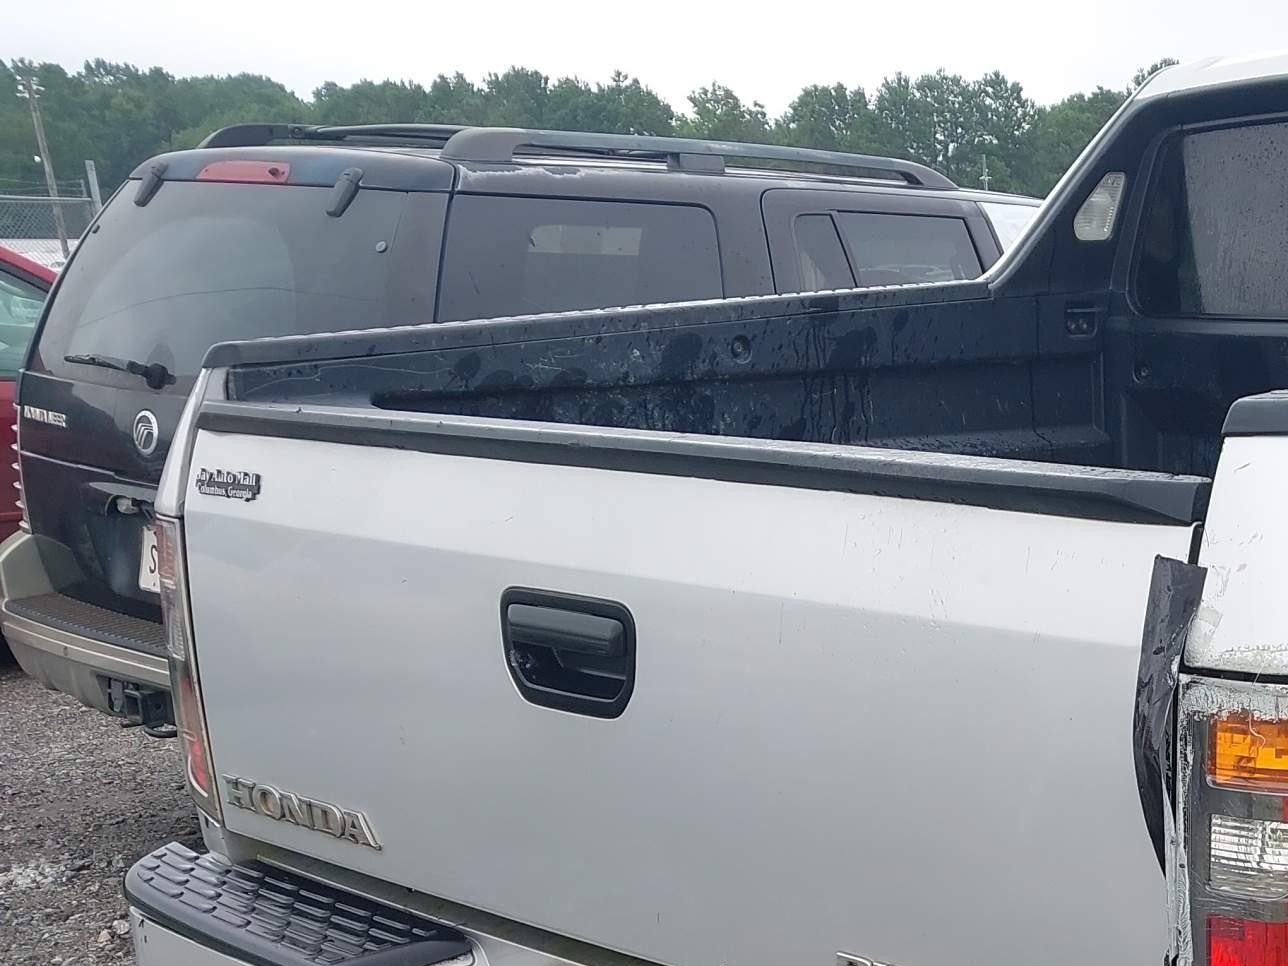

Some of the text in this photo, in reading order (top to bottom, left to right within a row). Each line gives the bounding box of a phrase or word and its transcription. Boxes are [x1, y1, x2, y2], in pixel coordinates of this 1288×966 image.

[211, 470, 234, 483] Auto
[235, 471, 256, 486] Mall
[221, 773, 382, 851] HONDA
